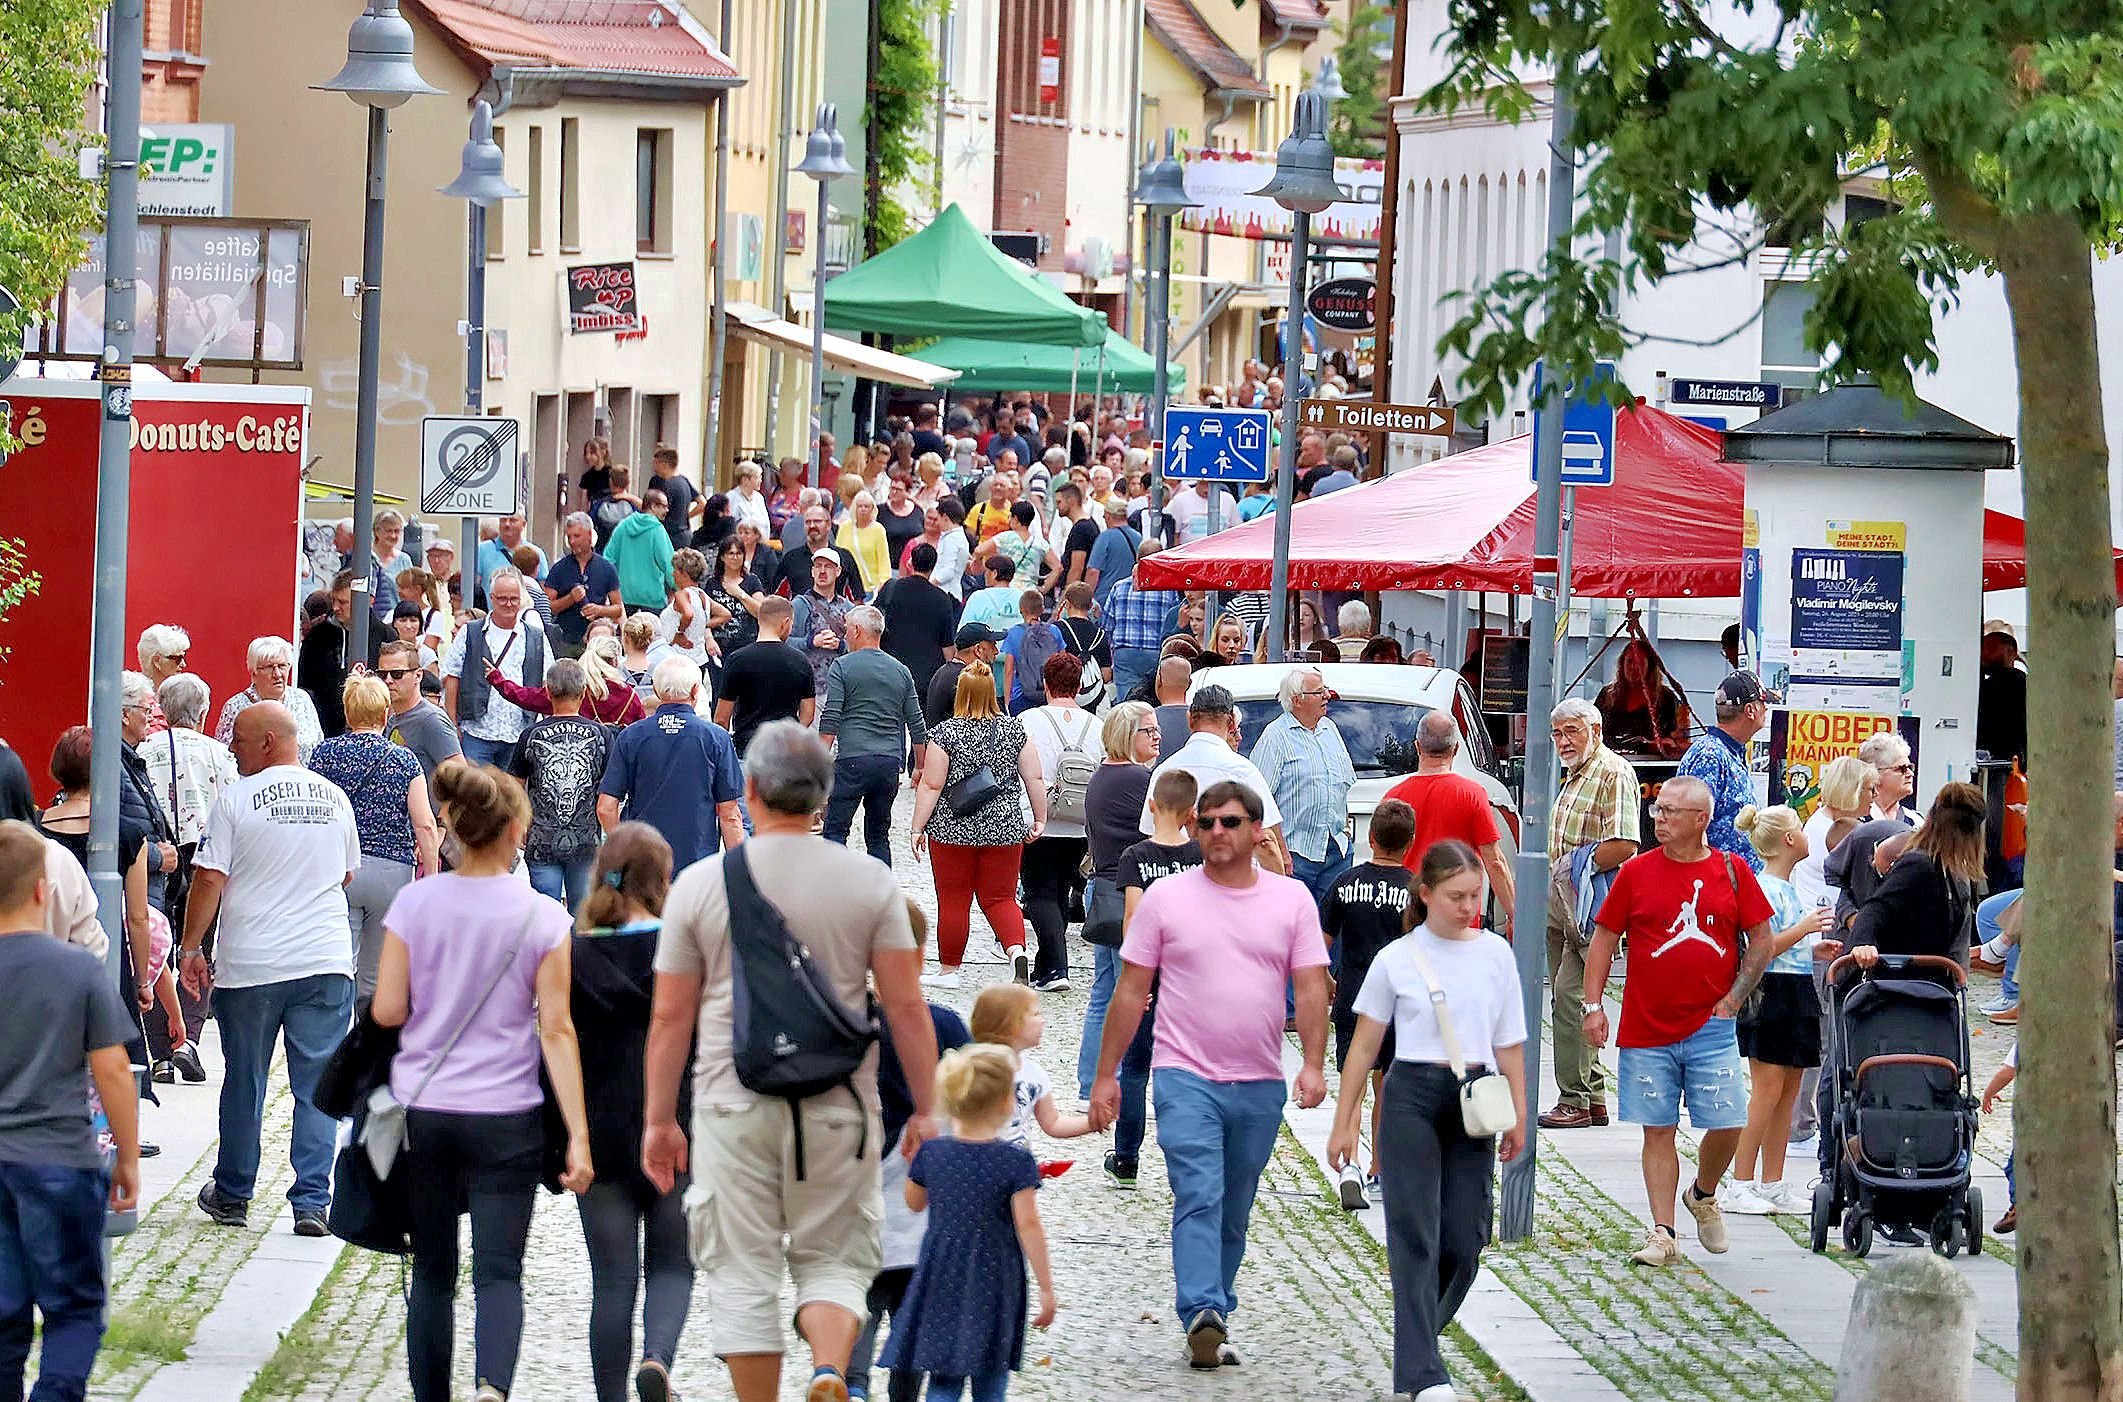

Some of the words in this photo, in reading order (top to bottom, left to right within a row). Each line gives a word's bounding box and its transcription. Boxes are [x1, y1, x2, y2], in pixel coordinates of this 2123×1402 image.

[140, 139, 217, 173] EP:
[571, 267, 633, 290] Rice
[596, 287, 634, 310] up
[1324, 310, 1360, 319] COMPANY
[1688, 384, 1766, 402] Marienstraße
[1335, 405, 1426, 430] Toiletten
[453, 443, 490, 473] 20
[446, 493, 493, 508] ZONE
[1836, 540, 1860, 548] DEINE
[1838, 533, 1864, 541] MEINE
[1817, 580, 1846, 591] PIANO
[1846, 575, 1879, 602] Nights
[1796, 597, 1838, 609] Vladimir
[1839, 598, 1899, 613] Mogilevsky
[1790, 742, 1861, 762] MÄNNC
[253, 781, 302, 811] DESERT
[1374, 880, 1412, 913] Ang
